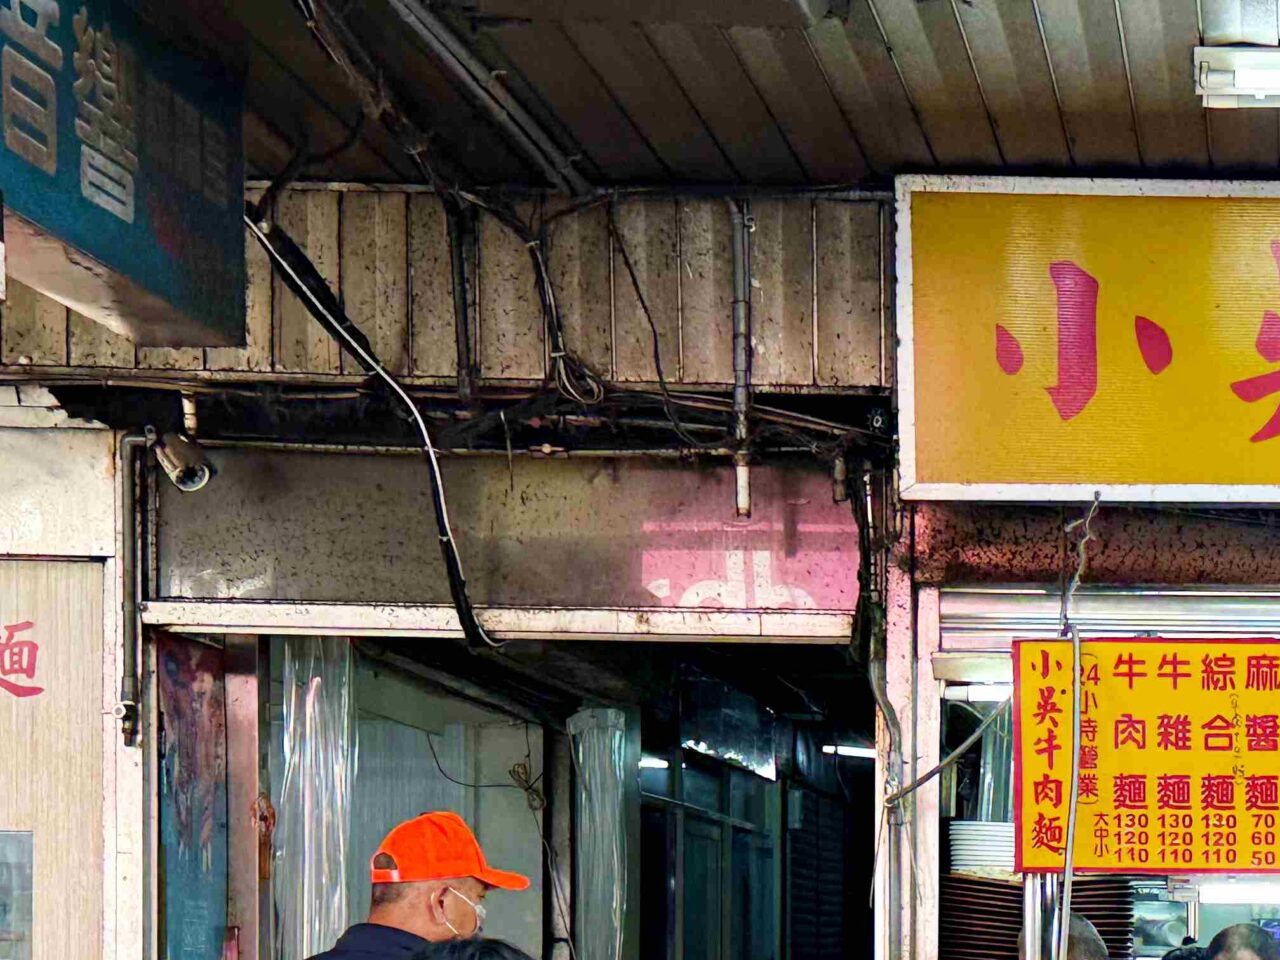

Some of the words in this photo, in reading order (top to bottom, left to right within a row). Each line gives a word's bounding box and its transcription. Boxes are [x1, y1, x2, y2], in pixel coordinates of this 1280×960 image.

[1030, 649, 1066, 855] 小吳牛肉麵
[1113, 652, 1148, 810] 牛肉麵
[1157, 652, 1192, 810] 牛雜麵
[1201, 653, 1236, 810] 綜合麵
[1245, 654, 1280, 811] 麻醬麵
[1113, 813, 1149, 829] 130
[1157, 813, 1193, 829] 130
[1201, 813, 1236, 829] 130
[1251, 814, 1275, 828] 70
[1113, 831, 1149, 846] 120
[1157, 831, 1193, 847] 120
[1201, 831, 1236, 846] 120
[1251, 831, 1275, 845] 60
[1113, 848, 1149, 863] 110
[1157, 848, 1193, 863] 110
[1201, 848, 1236, 863] 110
[1251, 851, 1275, 865] 50
